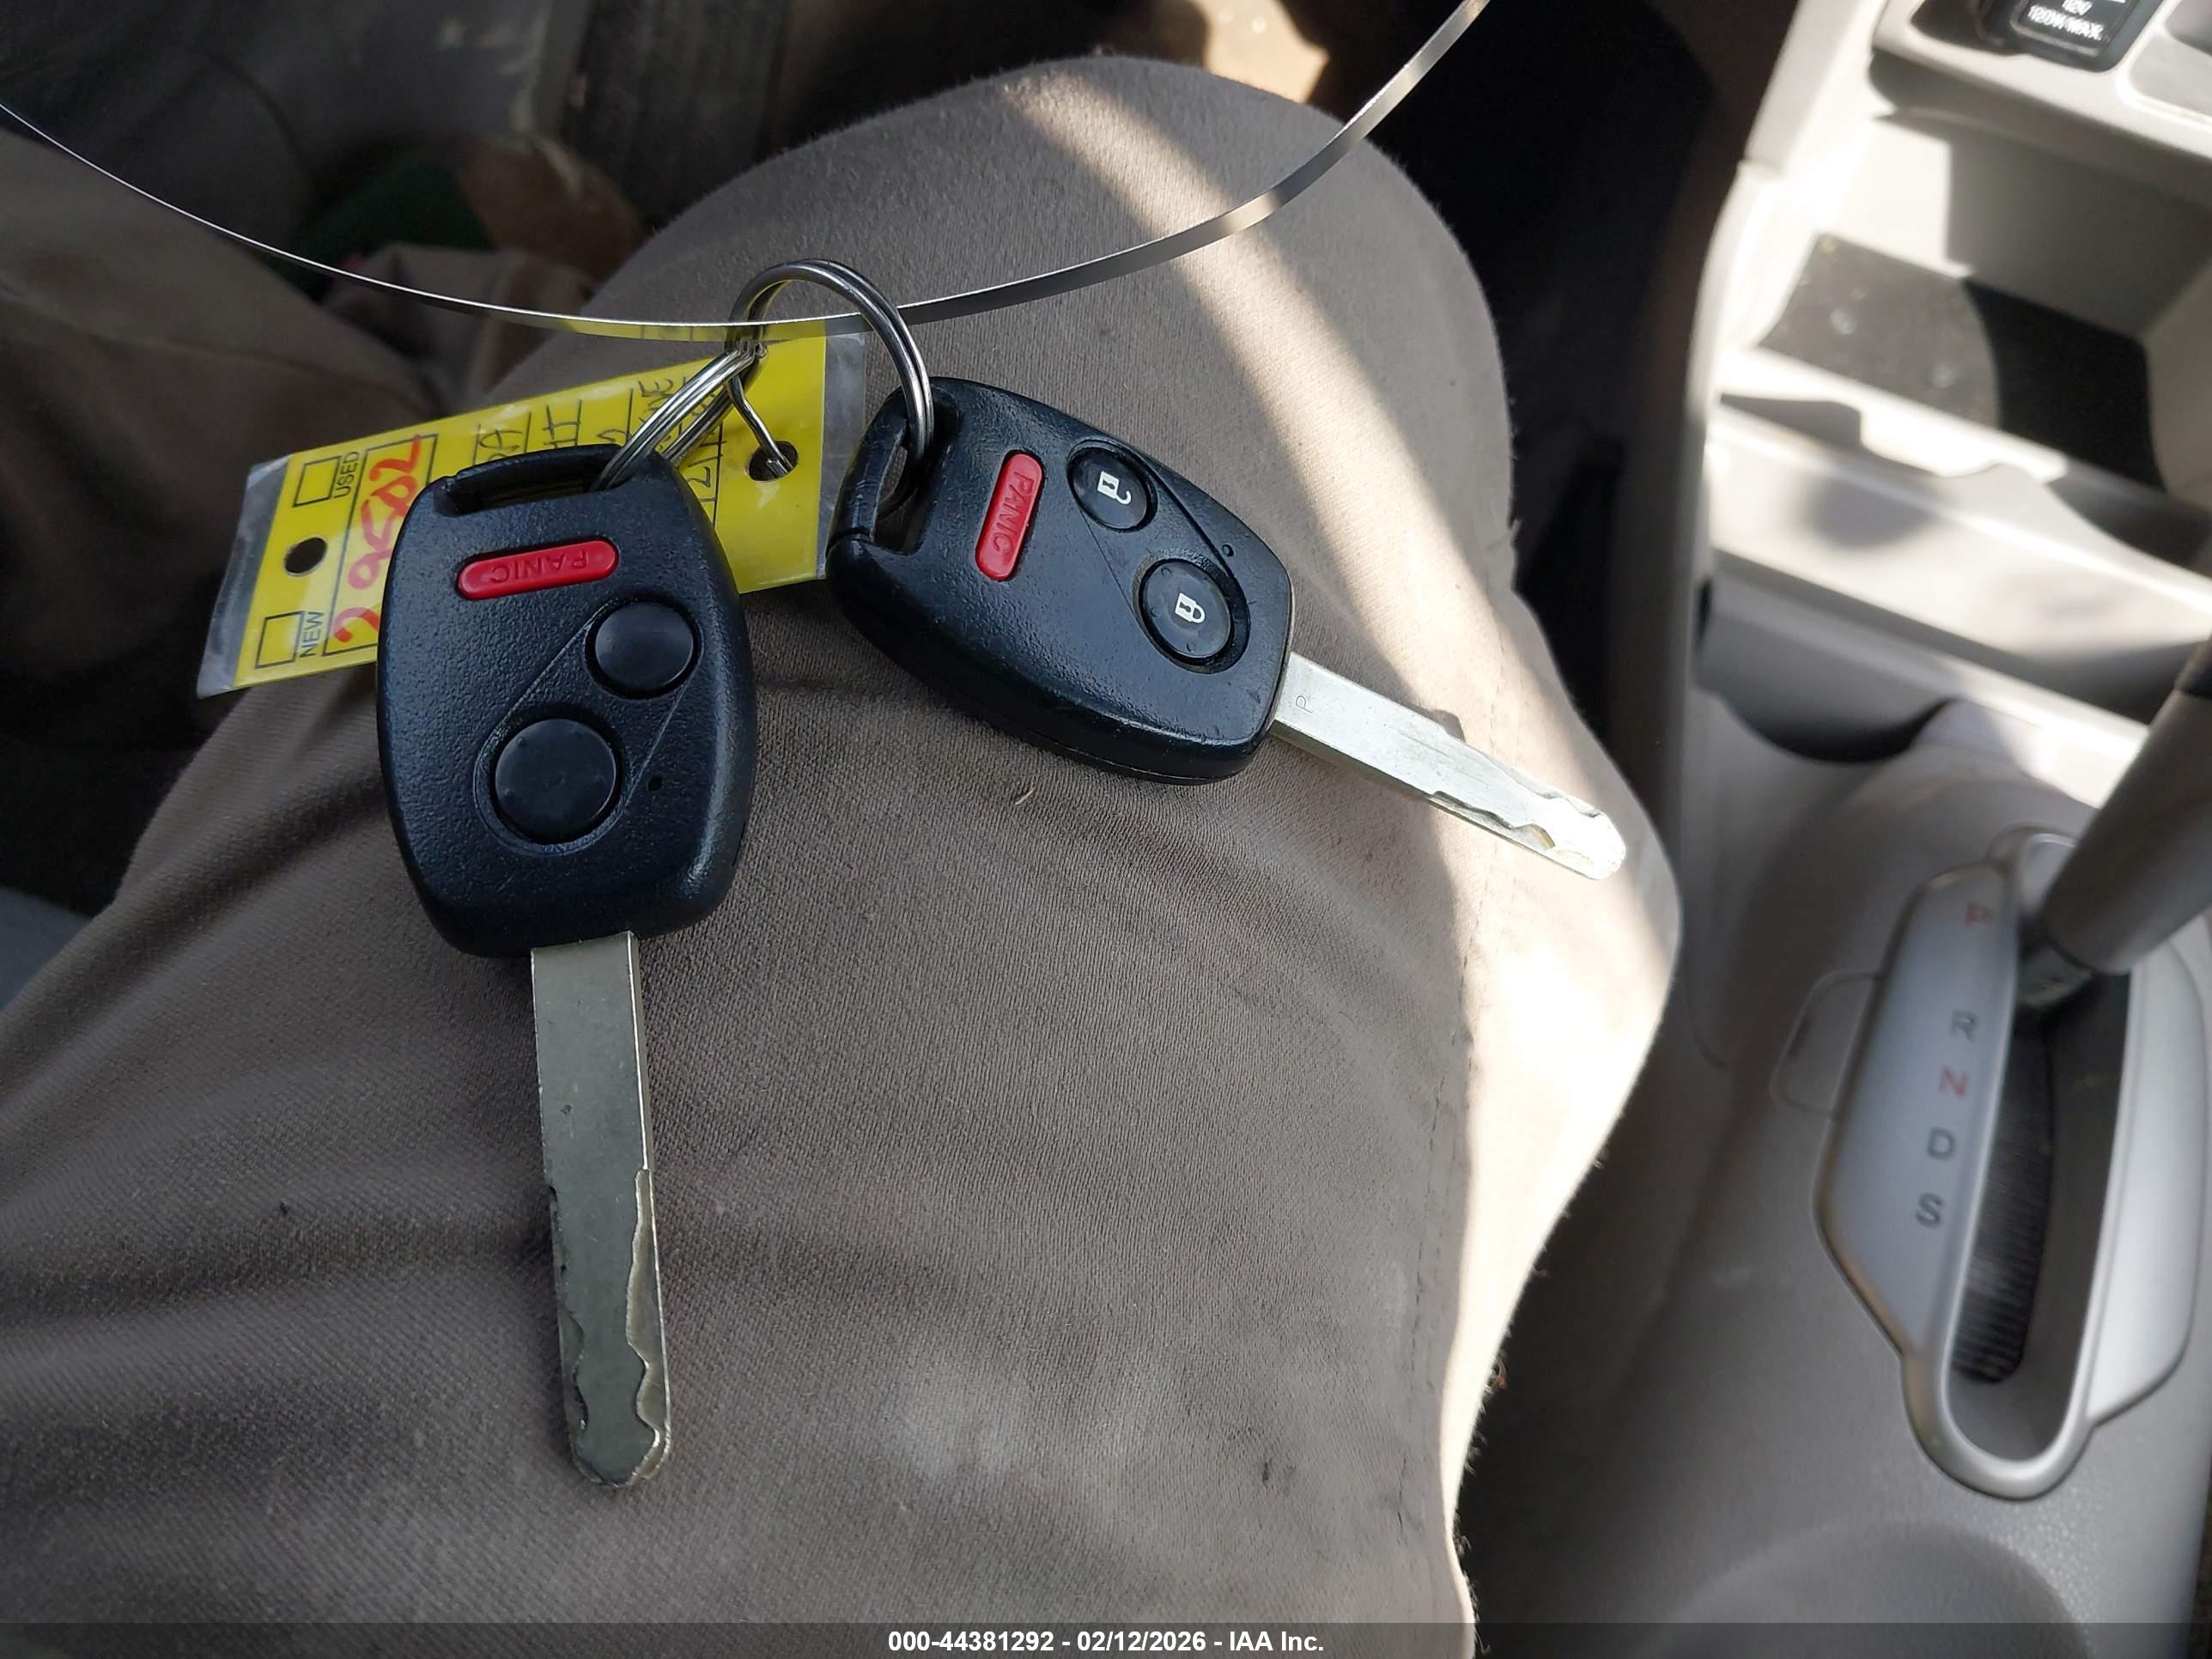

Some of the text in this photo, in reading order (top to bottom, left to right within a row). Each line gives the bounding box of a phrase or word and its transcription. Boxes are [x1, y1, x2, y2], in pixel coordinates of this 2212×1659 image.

[333, 451, 359, 499] USED
[993, 471, 1035, 552] PANIC
[489, 550, 589, 584] PANIC
[301, 611, 325, 659] NEW
[1965, 902, 1994, 927] P
[1951, 1009, 1978, 1042] R
[1938, 1066, 1967, 1098] N
[1926, 1127, 1956, 1159] D
[1915, 1193, 1943, 1227] S
